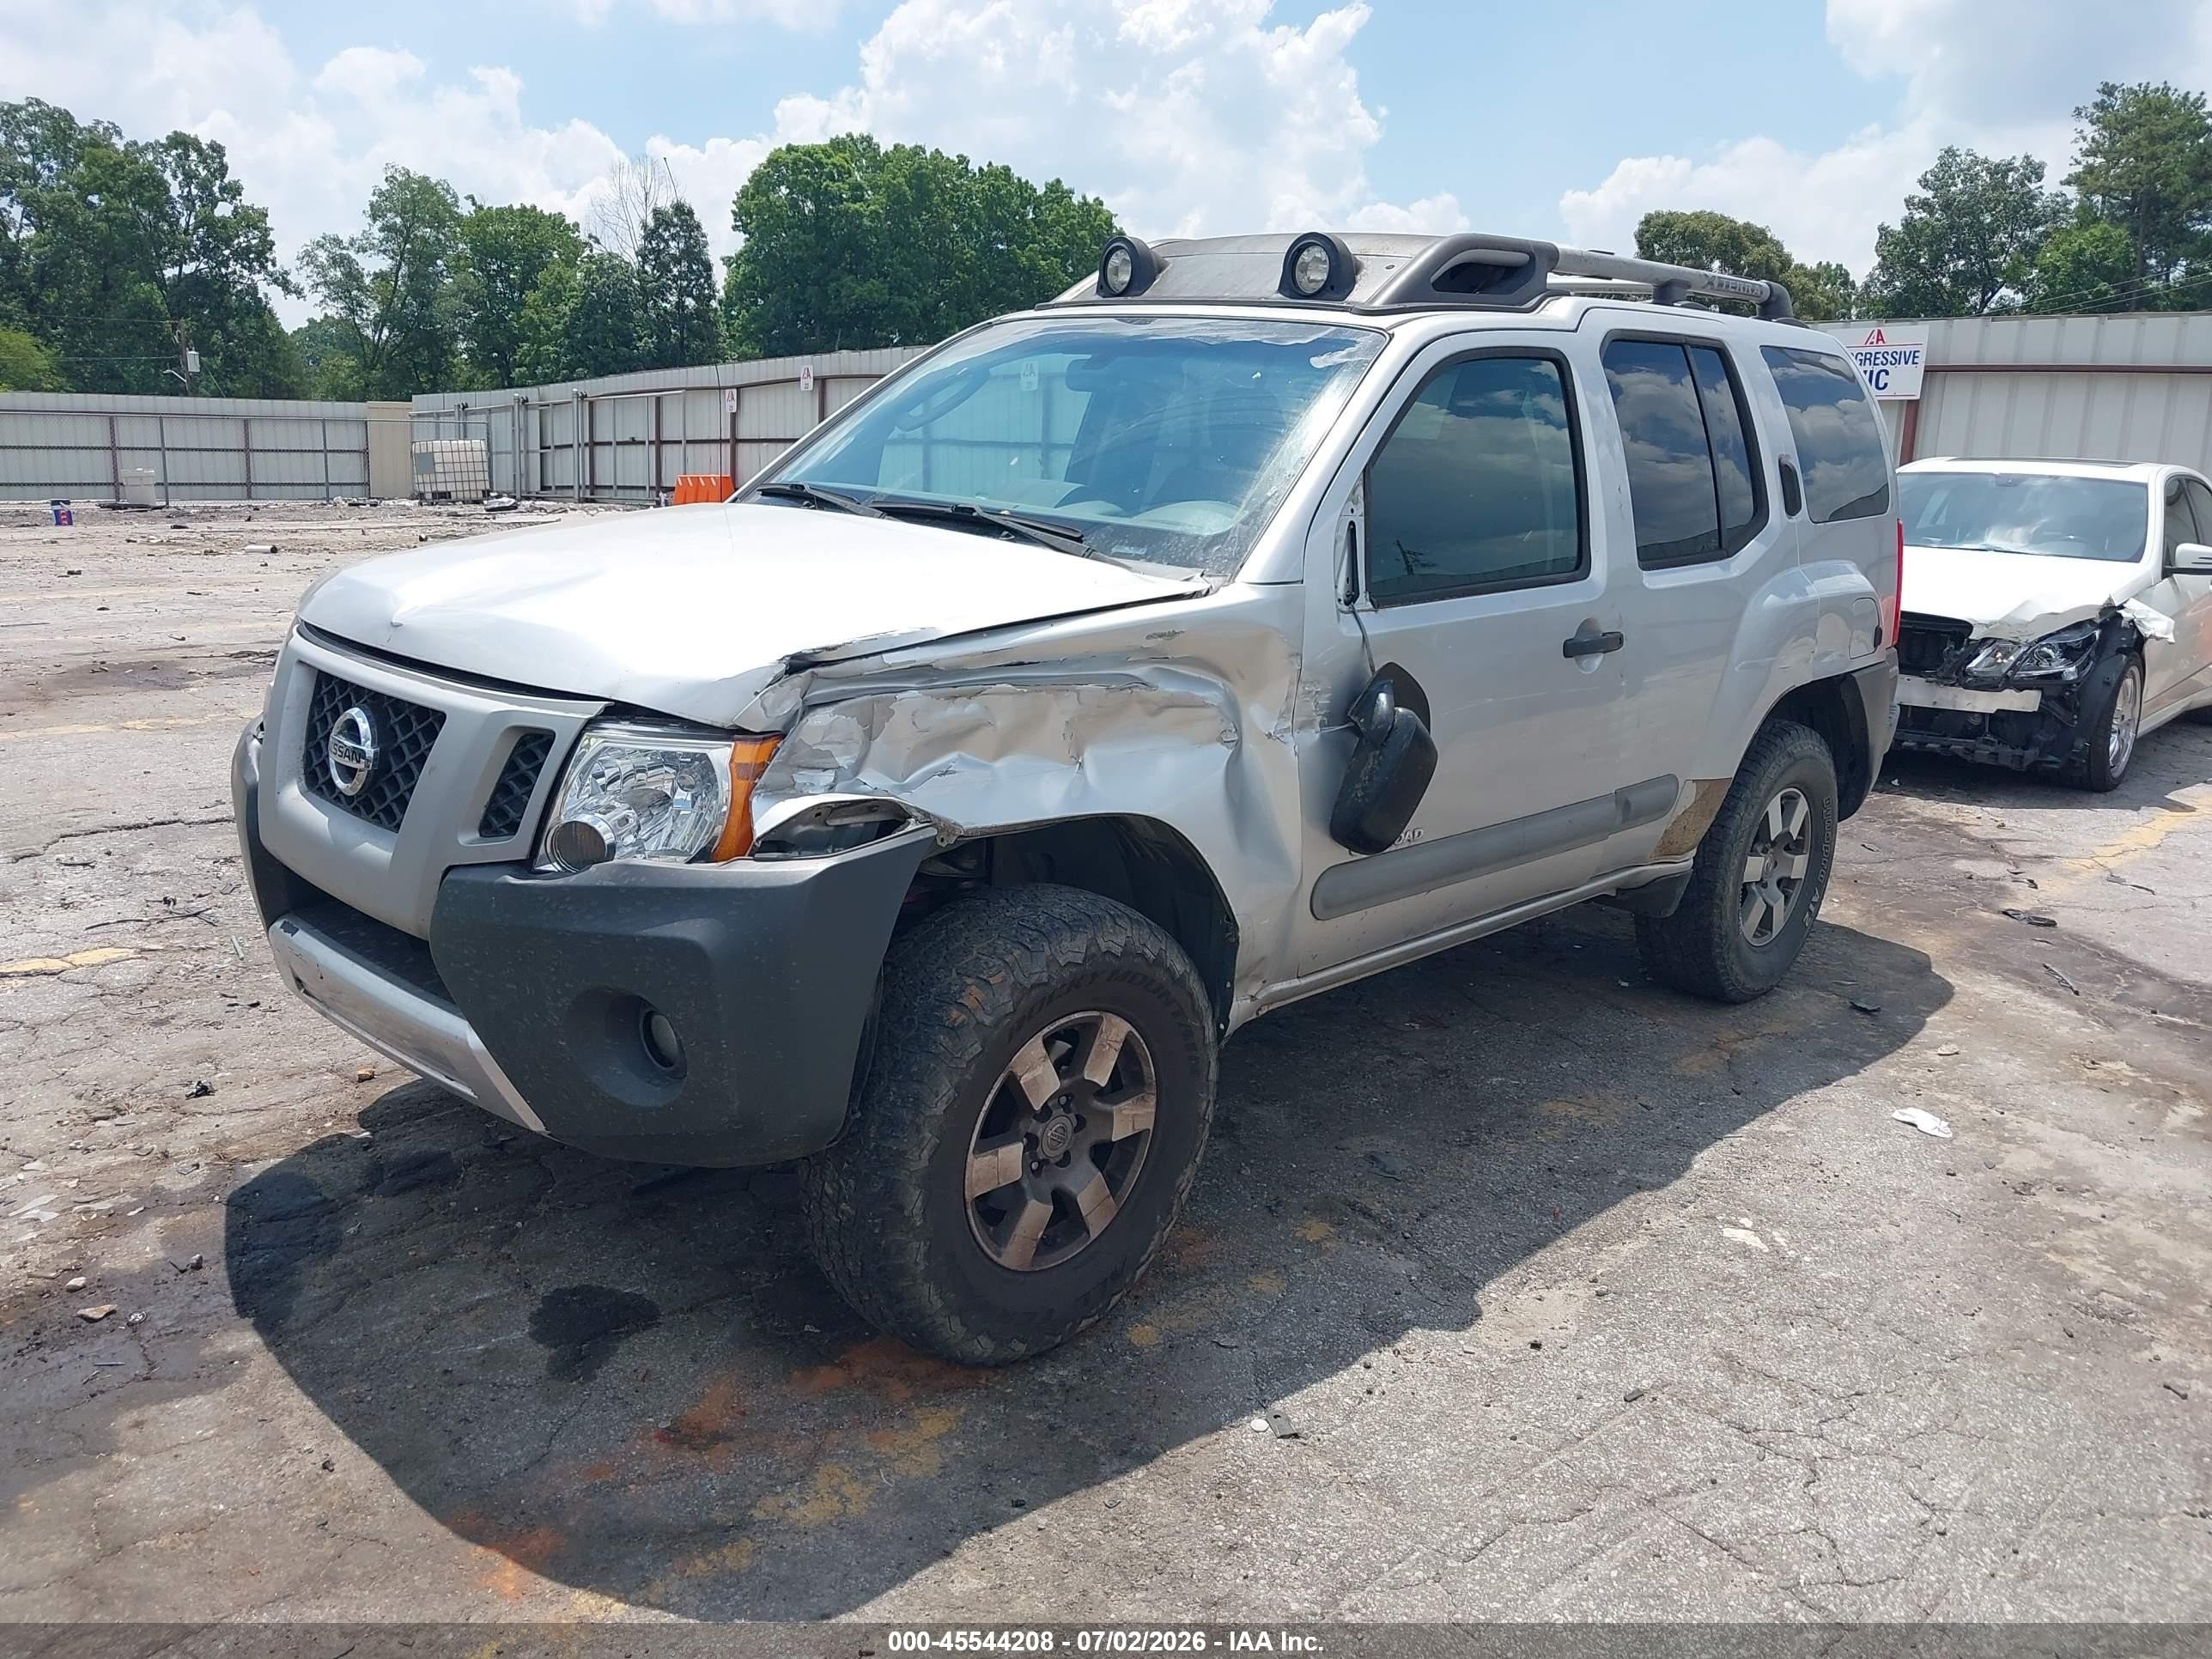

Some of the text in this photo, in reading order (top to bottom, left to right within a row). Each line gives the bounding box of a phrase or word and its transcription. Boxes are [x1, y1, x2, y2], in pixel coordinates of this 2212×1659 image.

[1851, 350, 1920, 367] GRESSIVE
[1863, 369, 1889, 391] IC
[329, 742, 362, 763] NISSAN
[1394, 828, 1424, 845] OAD
